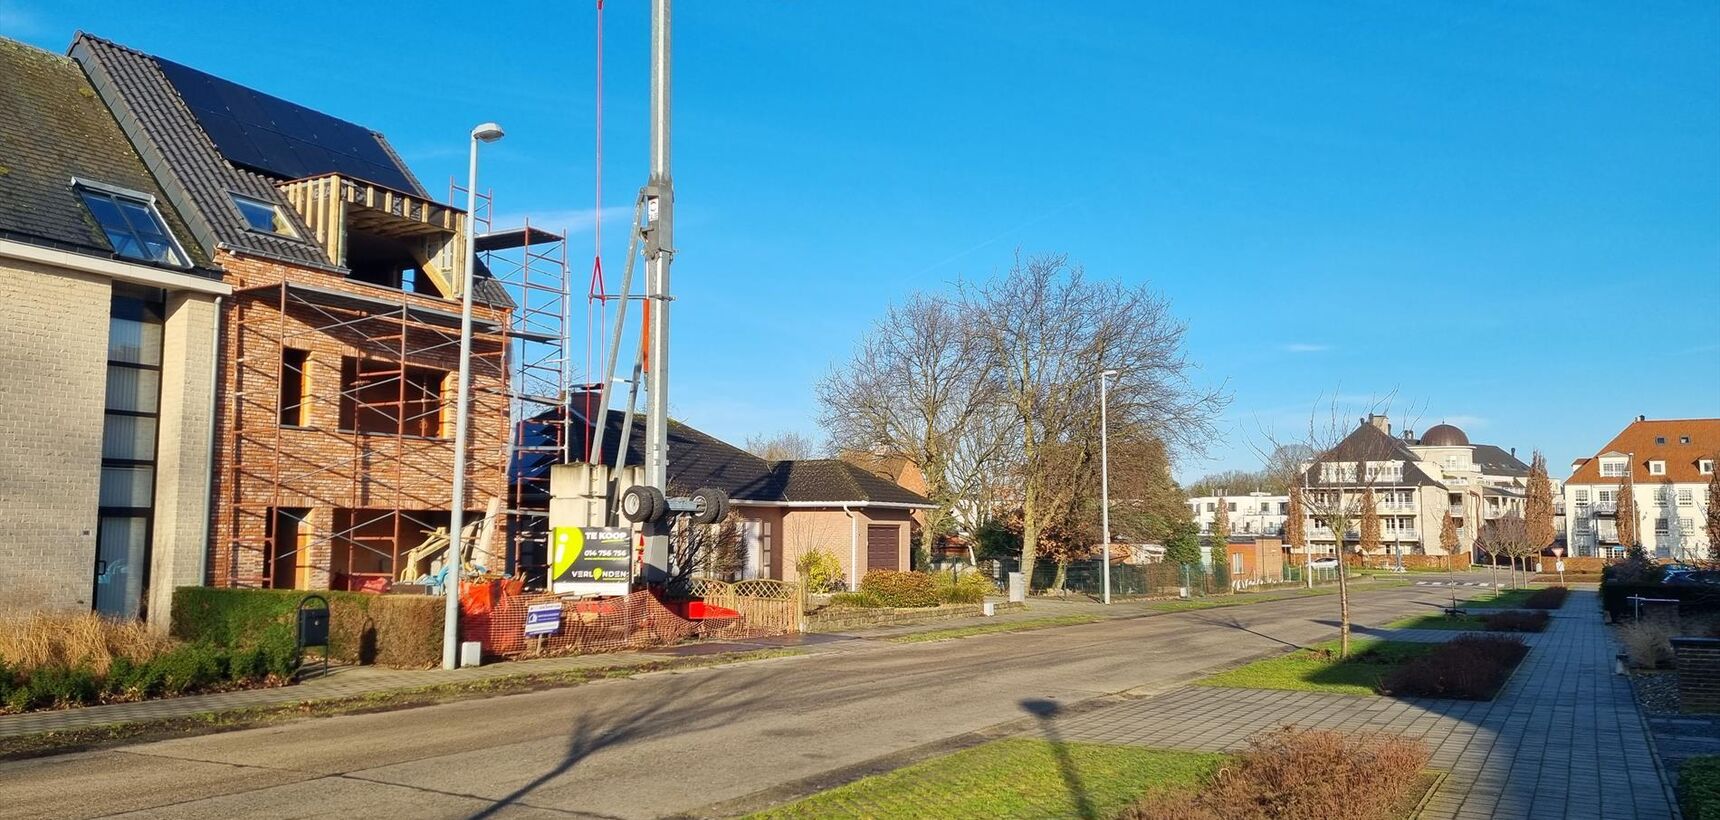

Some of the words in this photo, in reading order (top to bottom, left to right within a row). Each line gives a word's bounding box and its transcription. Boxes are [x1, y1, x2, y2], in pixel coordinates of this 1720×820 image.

[585, 532, 598, 540] TE
[598, 532, 627, 540] KOOP
[571, 568, 627, 579] VERLNDEN
